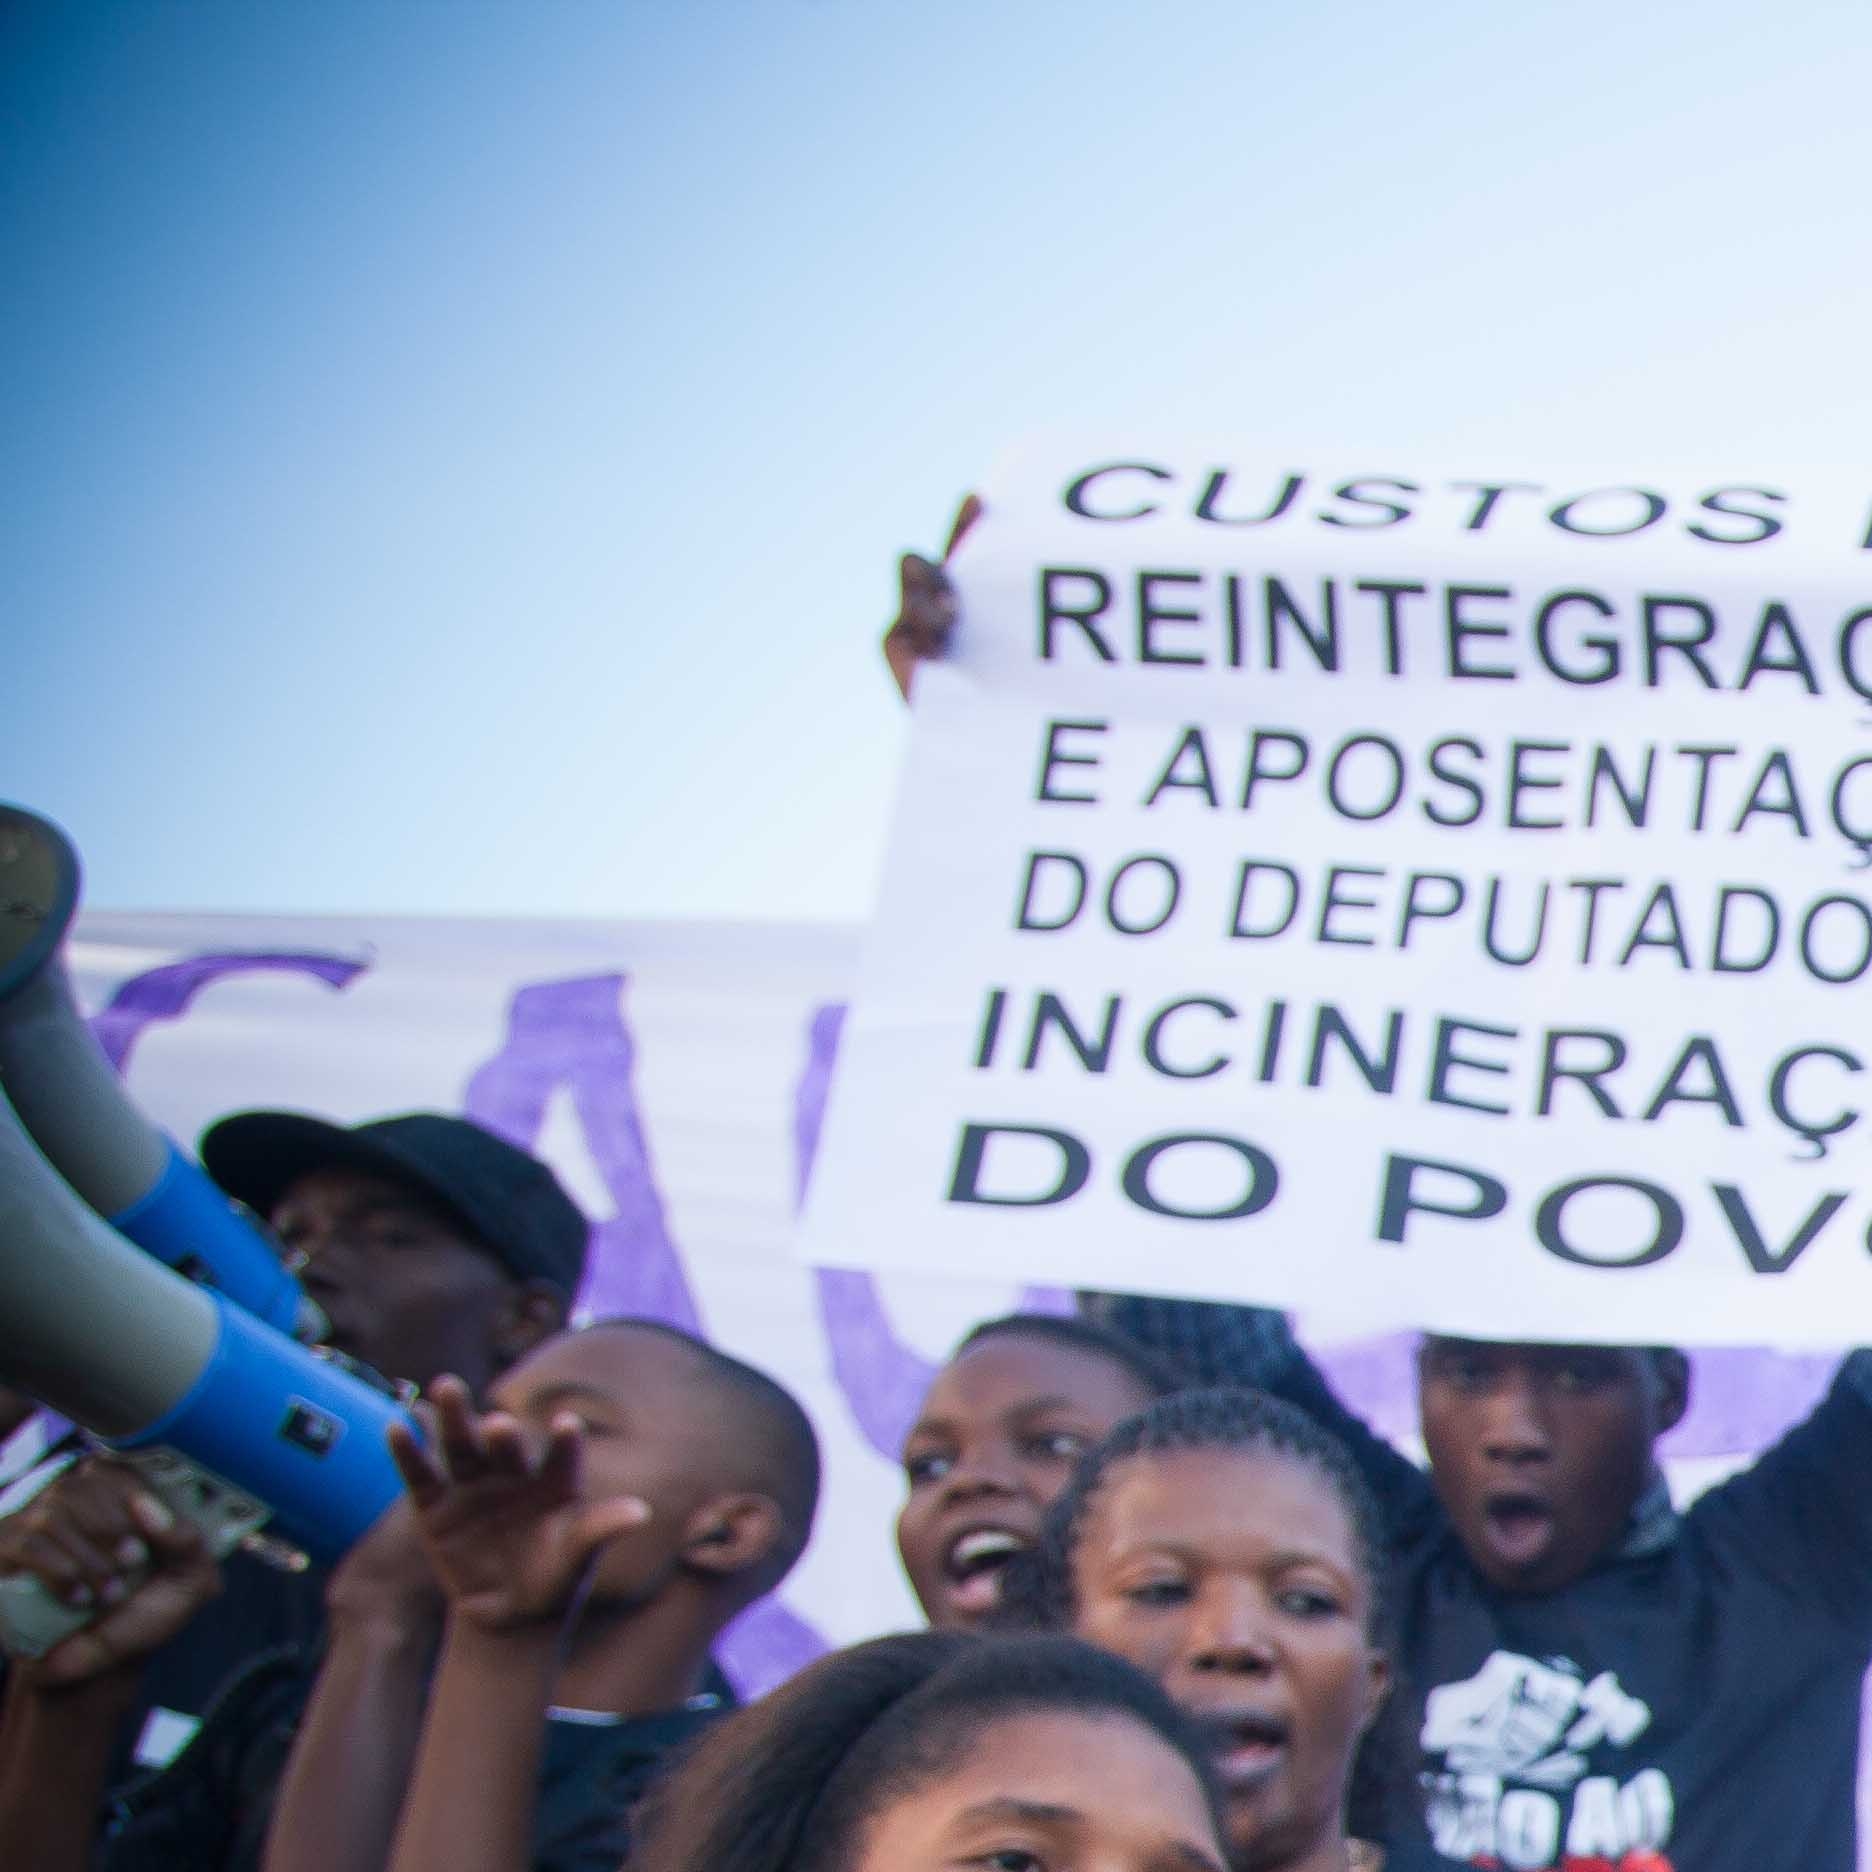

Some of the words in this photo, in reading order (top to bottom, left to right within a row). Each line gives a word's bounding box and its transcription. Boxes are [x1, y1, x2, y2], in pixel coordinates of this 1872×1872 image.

[1061, 462, 1789, 547] CUSTOS
[1035, 720, 1110, 805] E
[1013, 853, 1182, 937] DO
[944, 1122, 1280, 1219] DO
